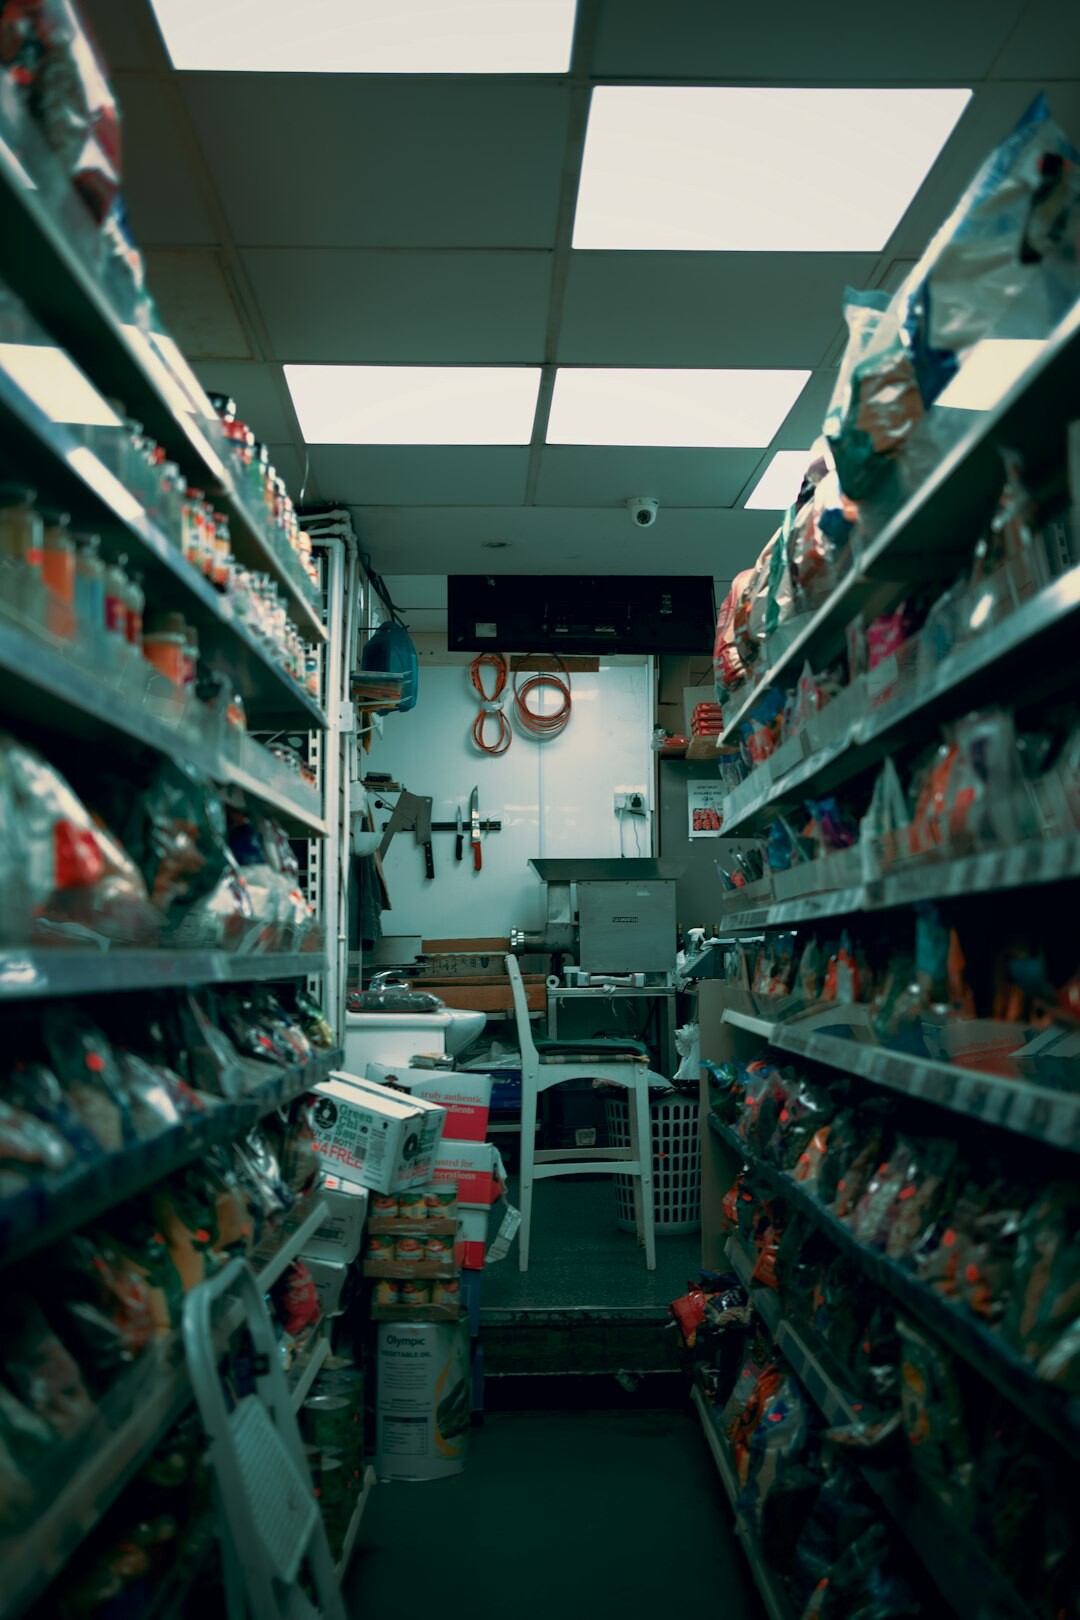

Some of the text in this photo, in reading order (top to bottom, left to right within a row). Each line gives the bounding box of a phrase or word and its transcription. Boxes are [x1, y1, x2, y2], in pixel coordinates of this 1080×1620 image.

[421, 1091, 482, 1103] truly authentic
[339, 1103, 373, 1124] Green
[447, 1104, 475, 1114] dients
[338, 1115, 358, 1130] Chi
[335, 1124, 357, 1141] Sau
[333, 1136, 354, 1150] BOTT
[329, 1144, 364, 1170] FREE
[386, 1334, 425, 1348] Olympic
[381, 1350, 418, 1358] VEGETABLE
